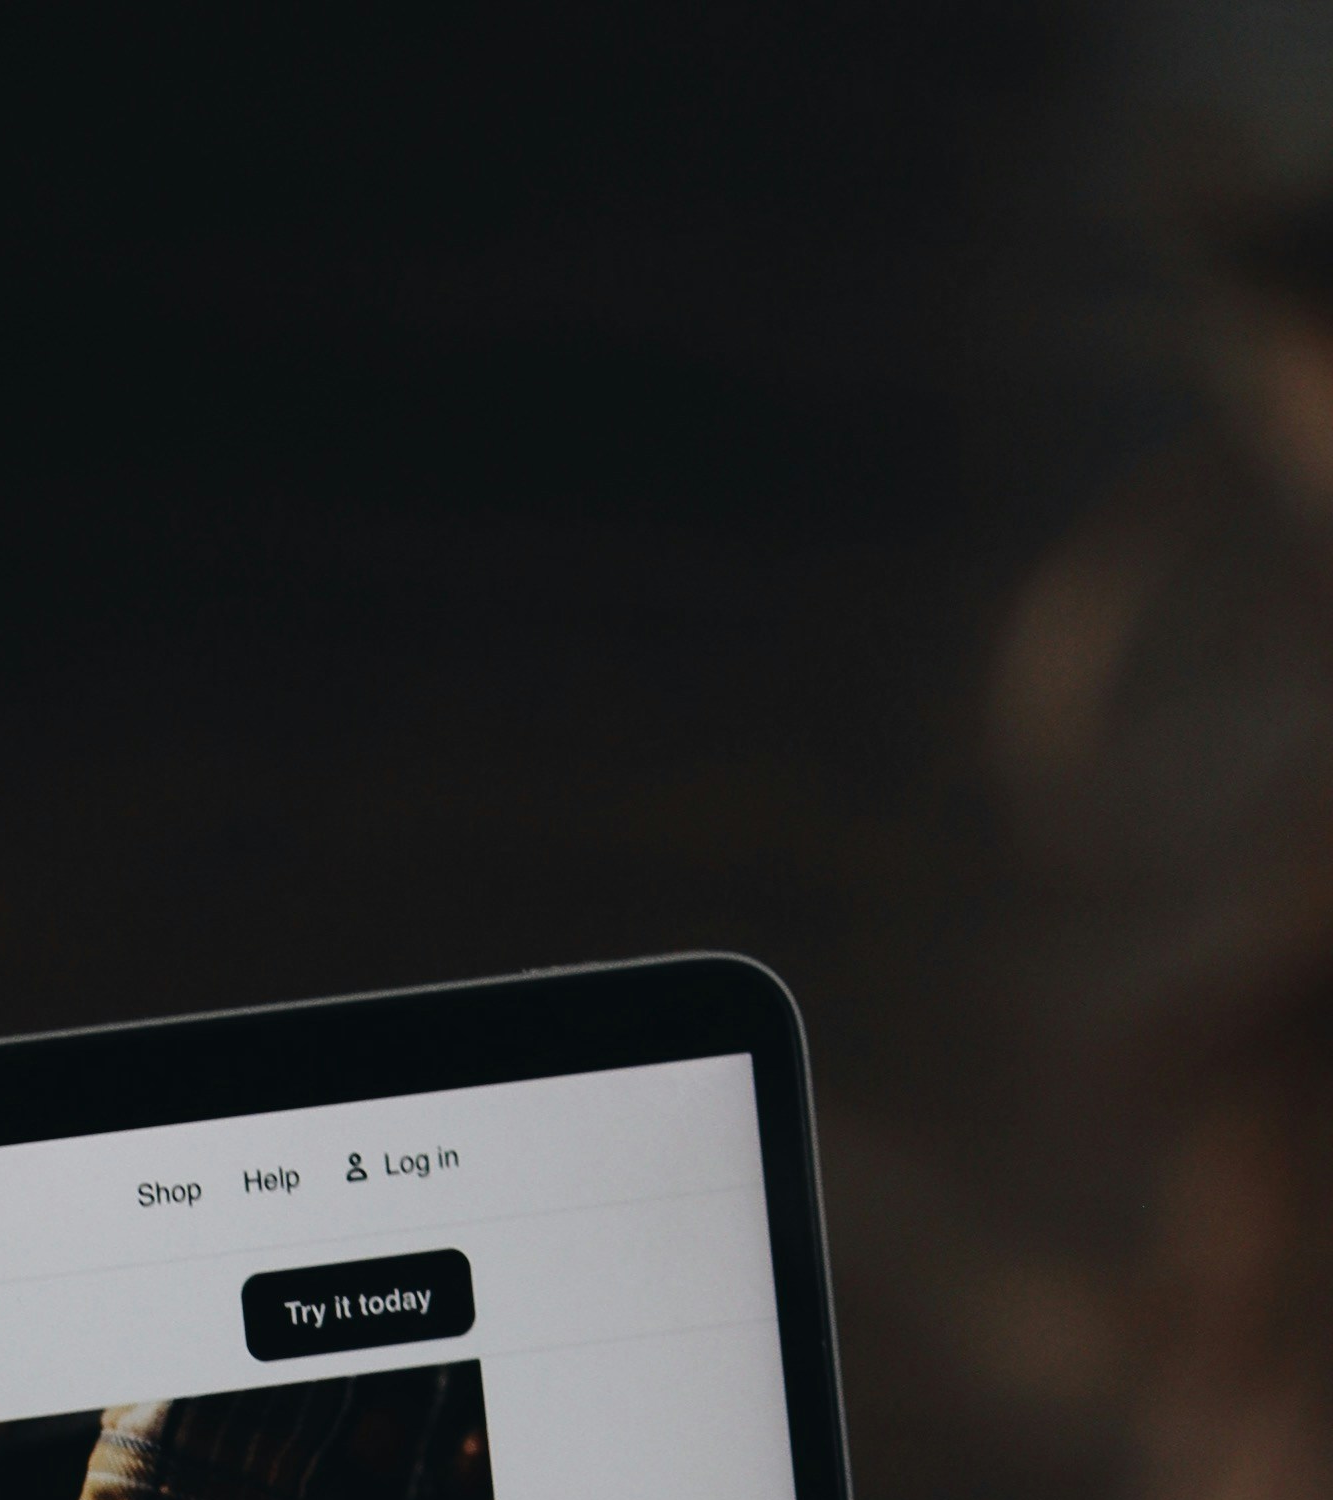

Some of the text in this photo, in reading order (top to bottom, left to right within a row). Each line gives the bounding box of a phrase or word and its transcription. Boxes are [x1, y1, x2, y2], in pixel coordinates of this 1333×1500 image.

[385, 1145, 460, 1177] Log in
[138, 1168, 299, 1206] Shop Help
[285, 1289, 430, 1327] Try it today
